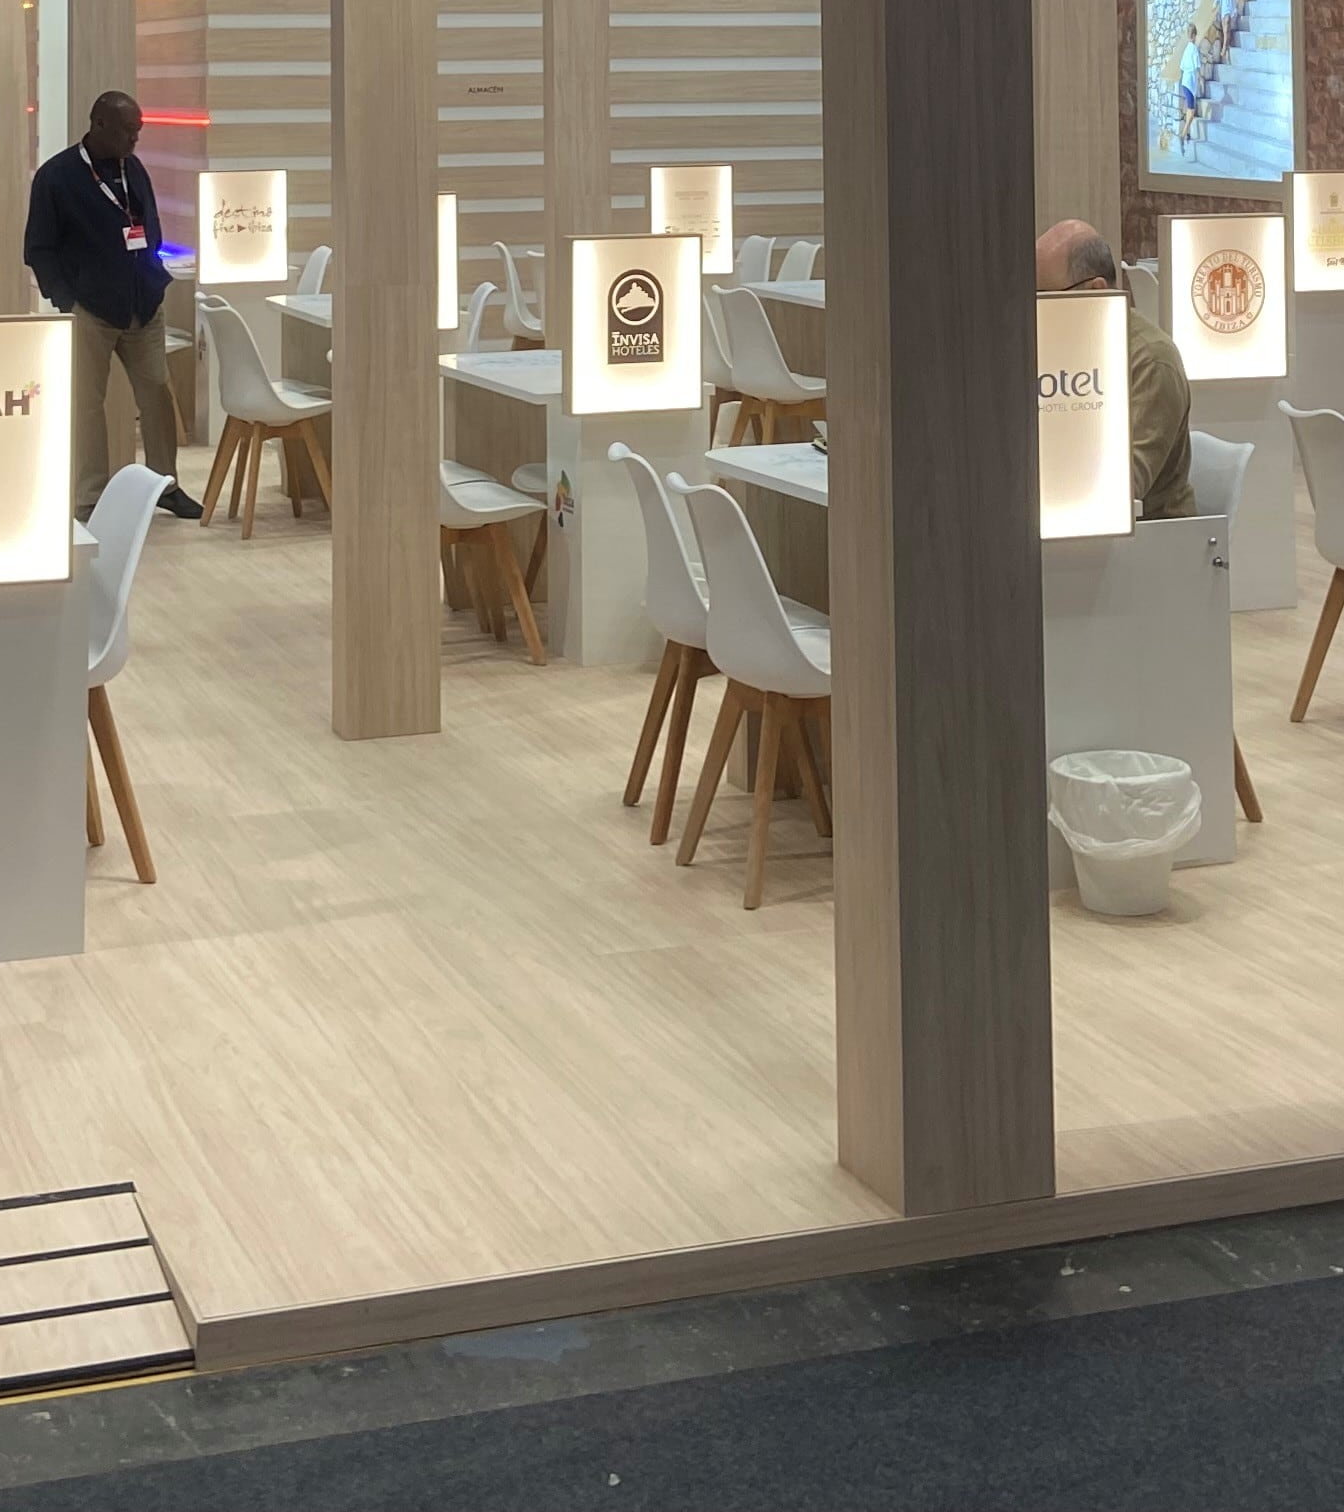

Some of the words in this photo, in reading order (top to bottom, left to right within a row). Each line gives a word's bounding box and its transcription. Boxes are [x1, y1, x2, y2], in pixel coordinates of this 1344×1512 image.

[1194, 255, 1220, 297] FOMENTO
[1222, 252, 1240, 264] DEL
[1242, 256, 1263, 298] TURISMO
[1214, 319, 1246, 330] IBIZA
[611, 331, 660, 347] INVISA
[612, 345, 660, 357] HOTELES
[1071, 400, 1104, 412] GROUP
